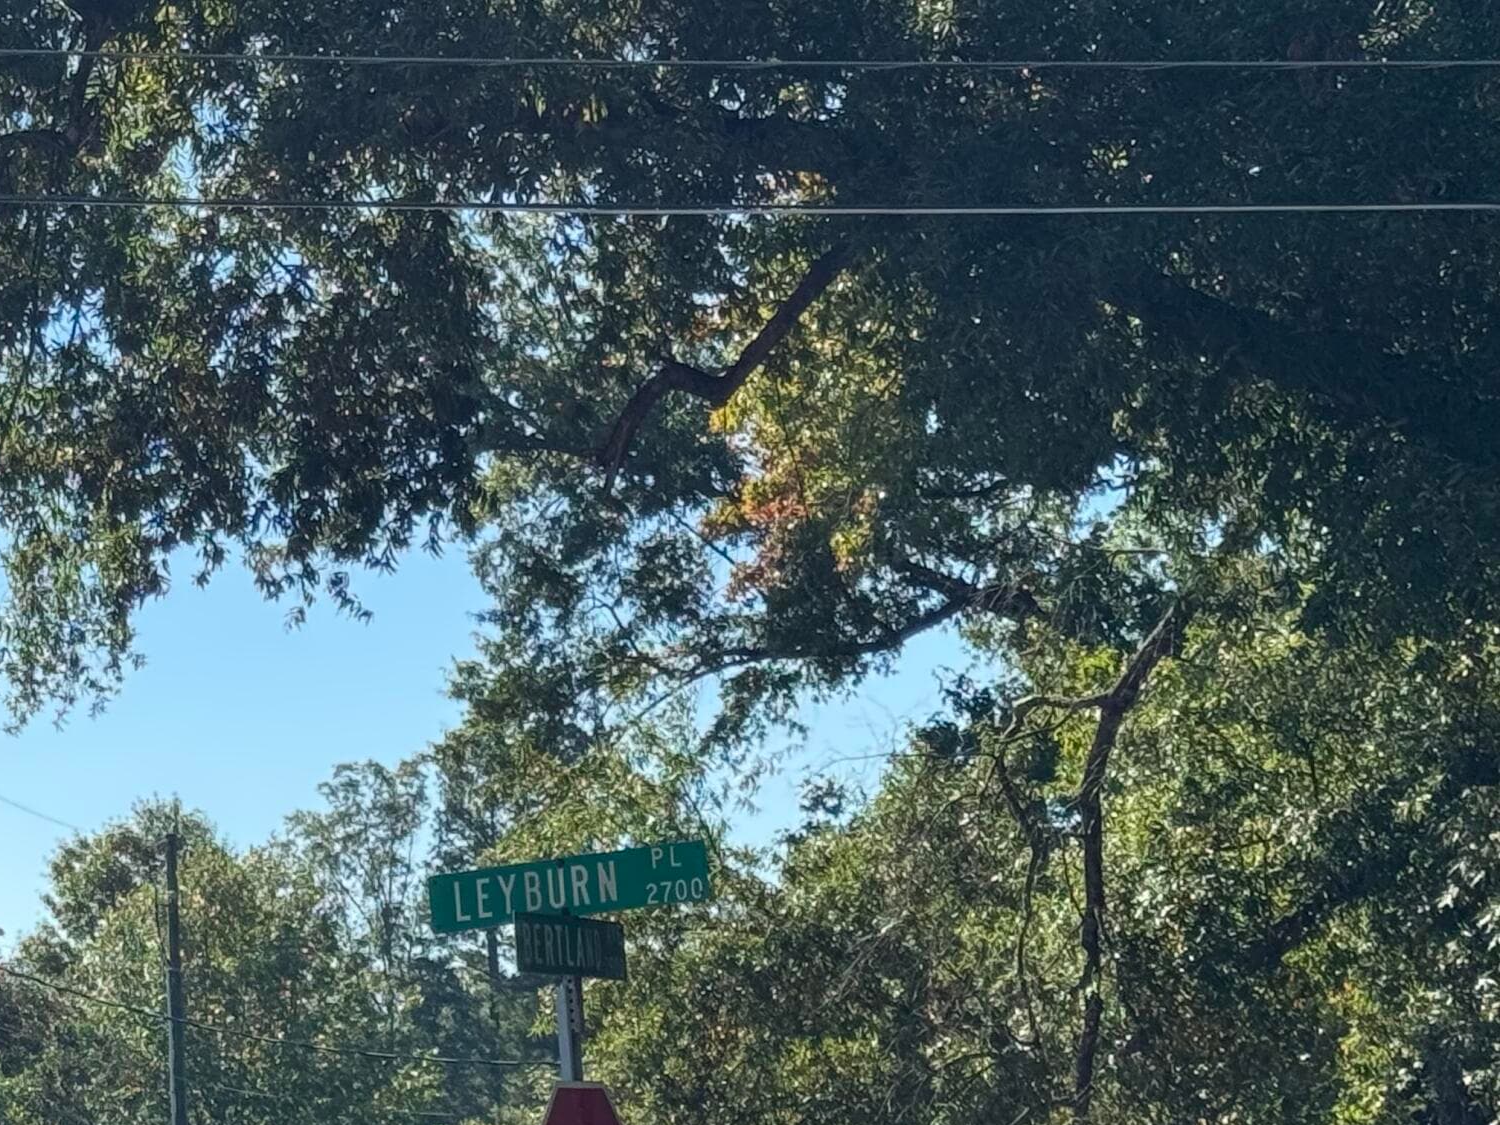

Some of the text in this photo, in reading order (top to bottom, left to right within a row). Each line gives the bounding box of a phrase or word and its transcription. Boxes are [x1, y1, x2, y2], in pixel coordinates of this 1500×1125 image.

[453, 847, 682, 923] LEYBURN PL
[646, 878, 704, 905] 2700
